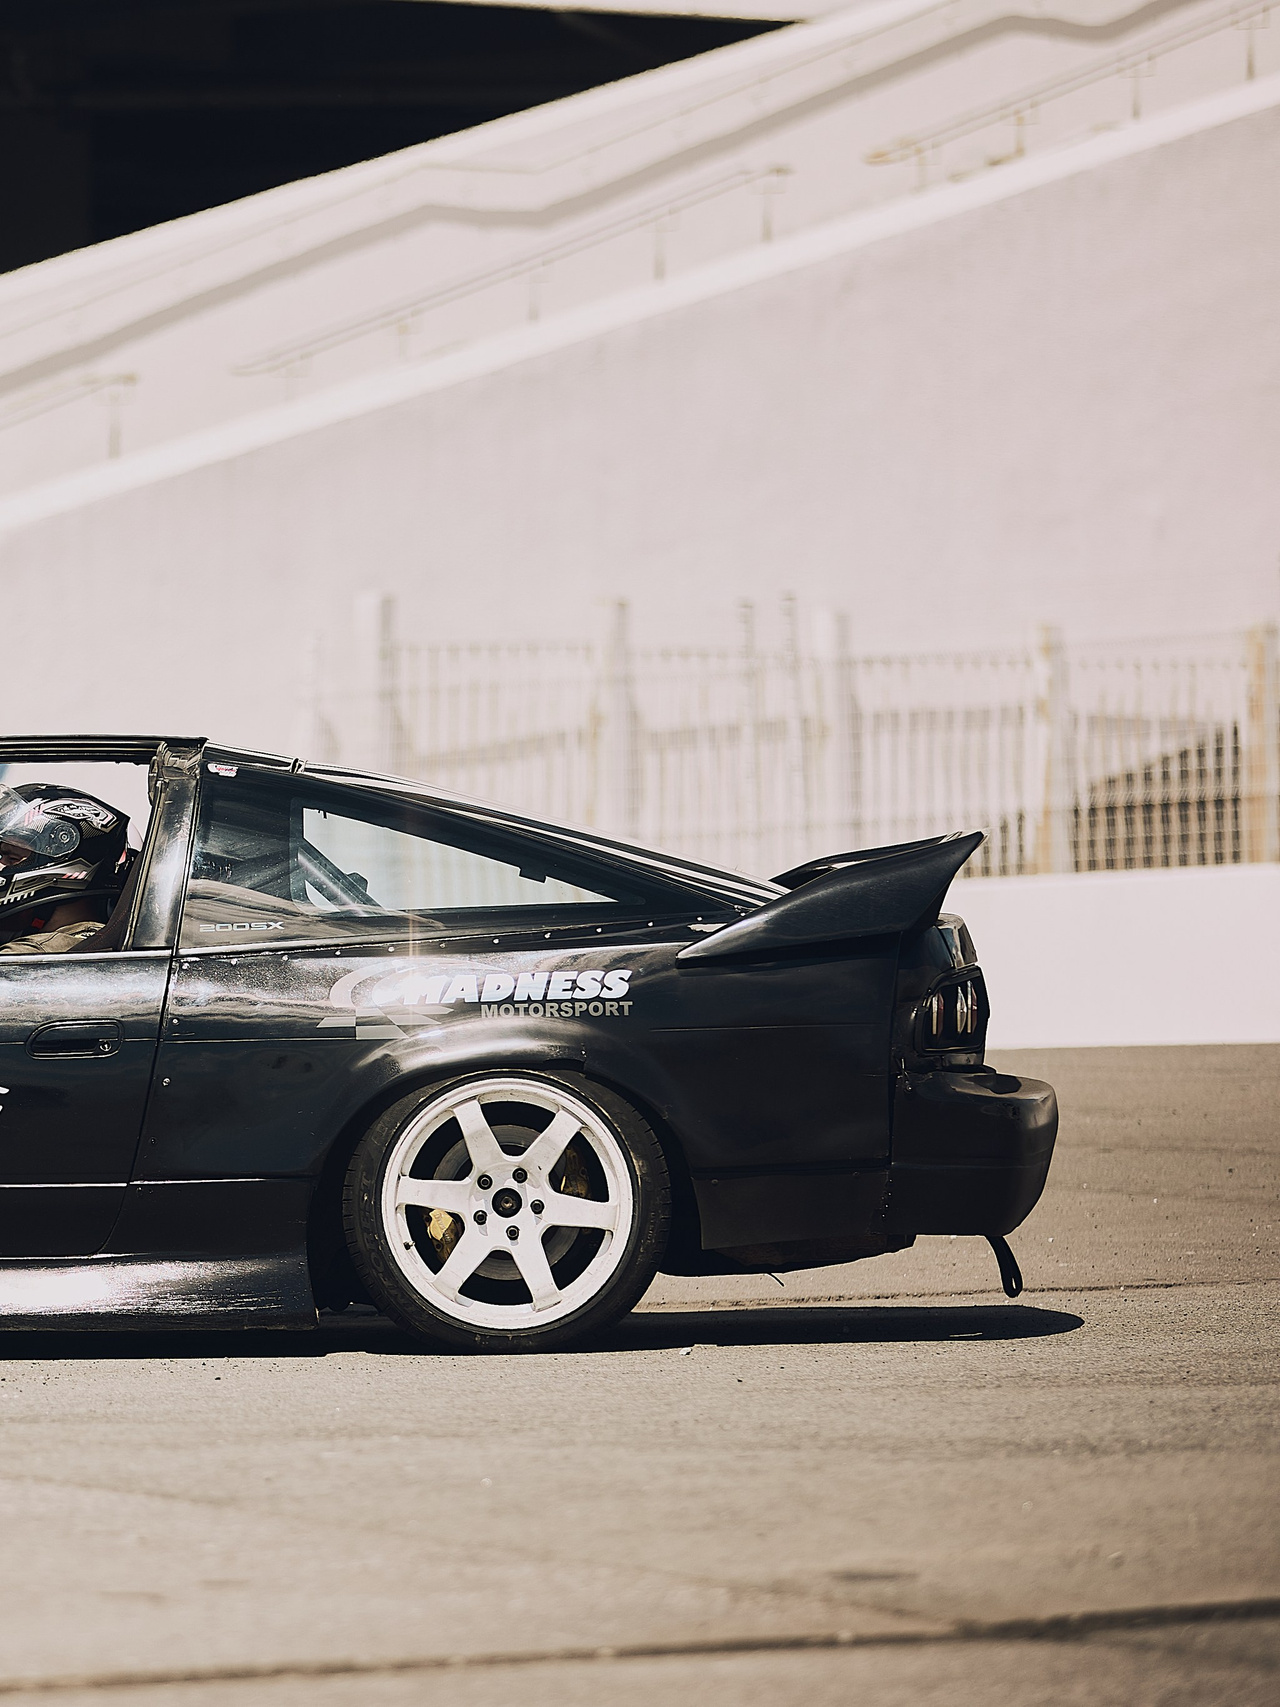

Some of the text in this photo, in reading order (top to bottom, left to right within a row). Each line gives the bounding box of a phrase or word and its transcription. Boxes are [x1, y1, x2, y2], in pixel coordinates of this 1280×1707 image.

[200, 921, 285, 933] 200SX
[400, 969, 633, 1005] MADNESS
[481, 1000, 634, 1019] MOTORSPORT
